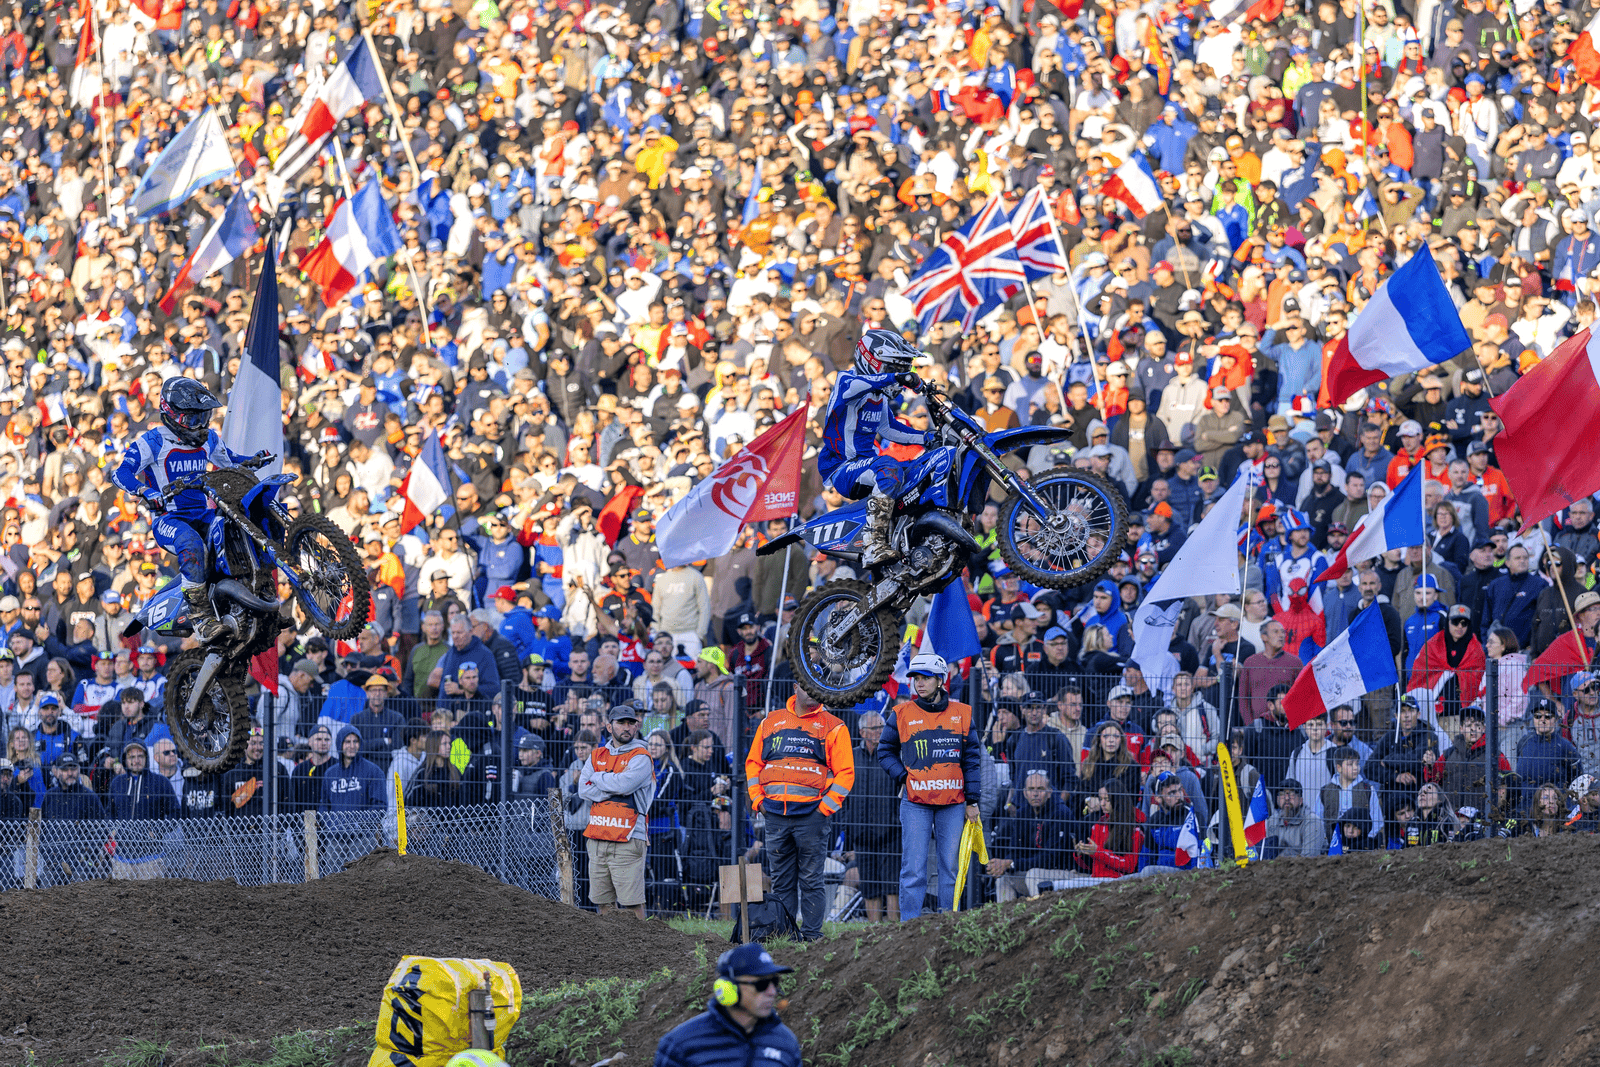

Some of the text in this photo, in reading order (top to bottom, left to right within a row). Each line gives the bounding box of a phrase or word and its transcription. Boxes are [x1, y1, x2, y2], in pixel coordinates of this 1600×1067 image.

[169, 459, 208, 473] YAMAH
[812, 521, 845, 545] 111
[147, 599, 169, 627] 15
[910, 779, 963, 790] MARSHALL
